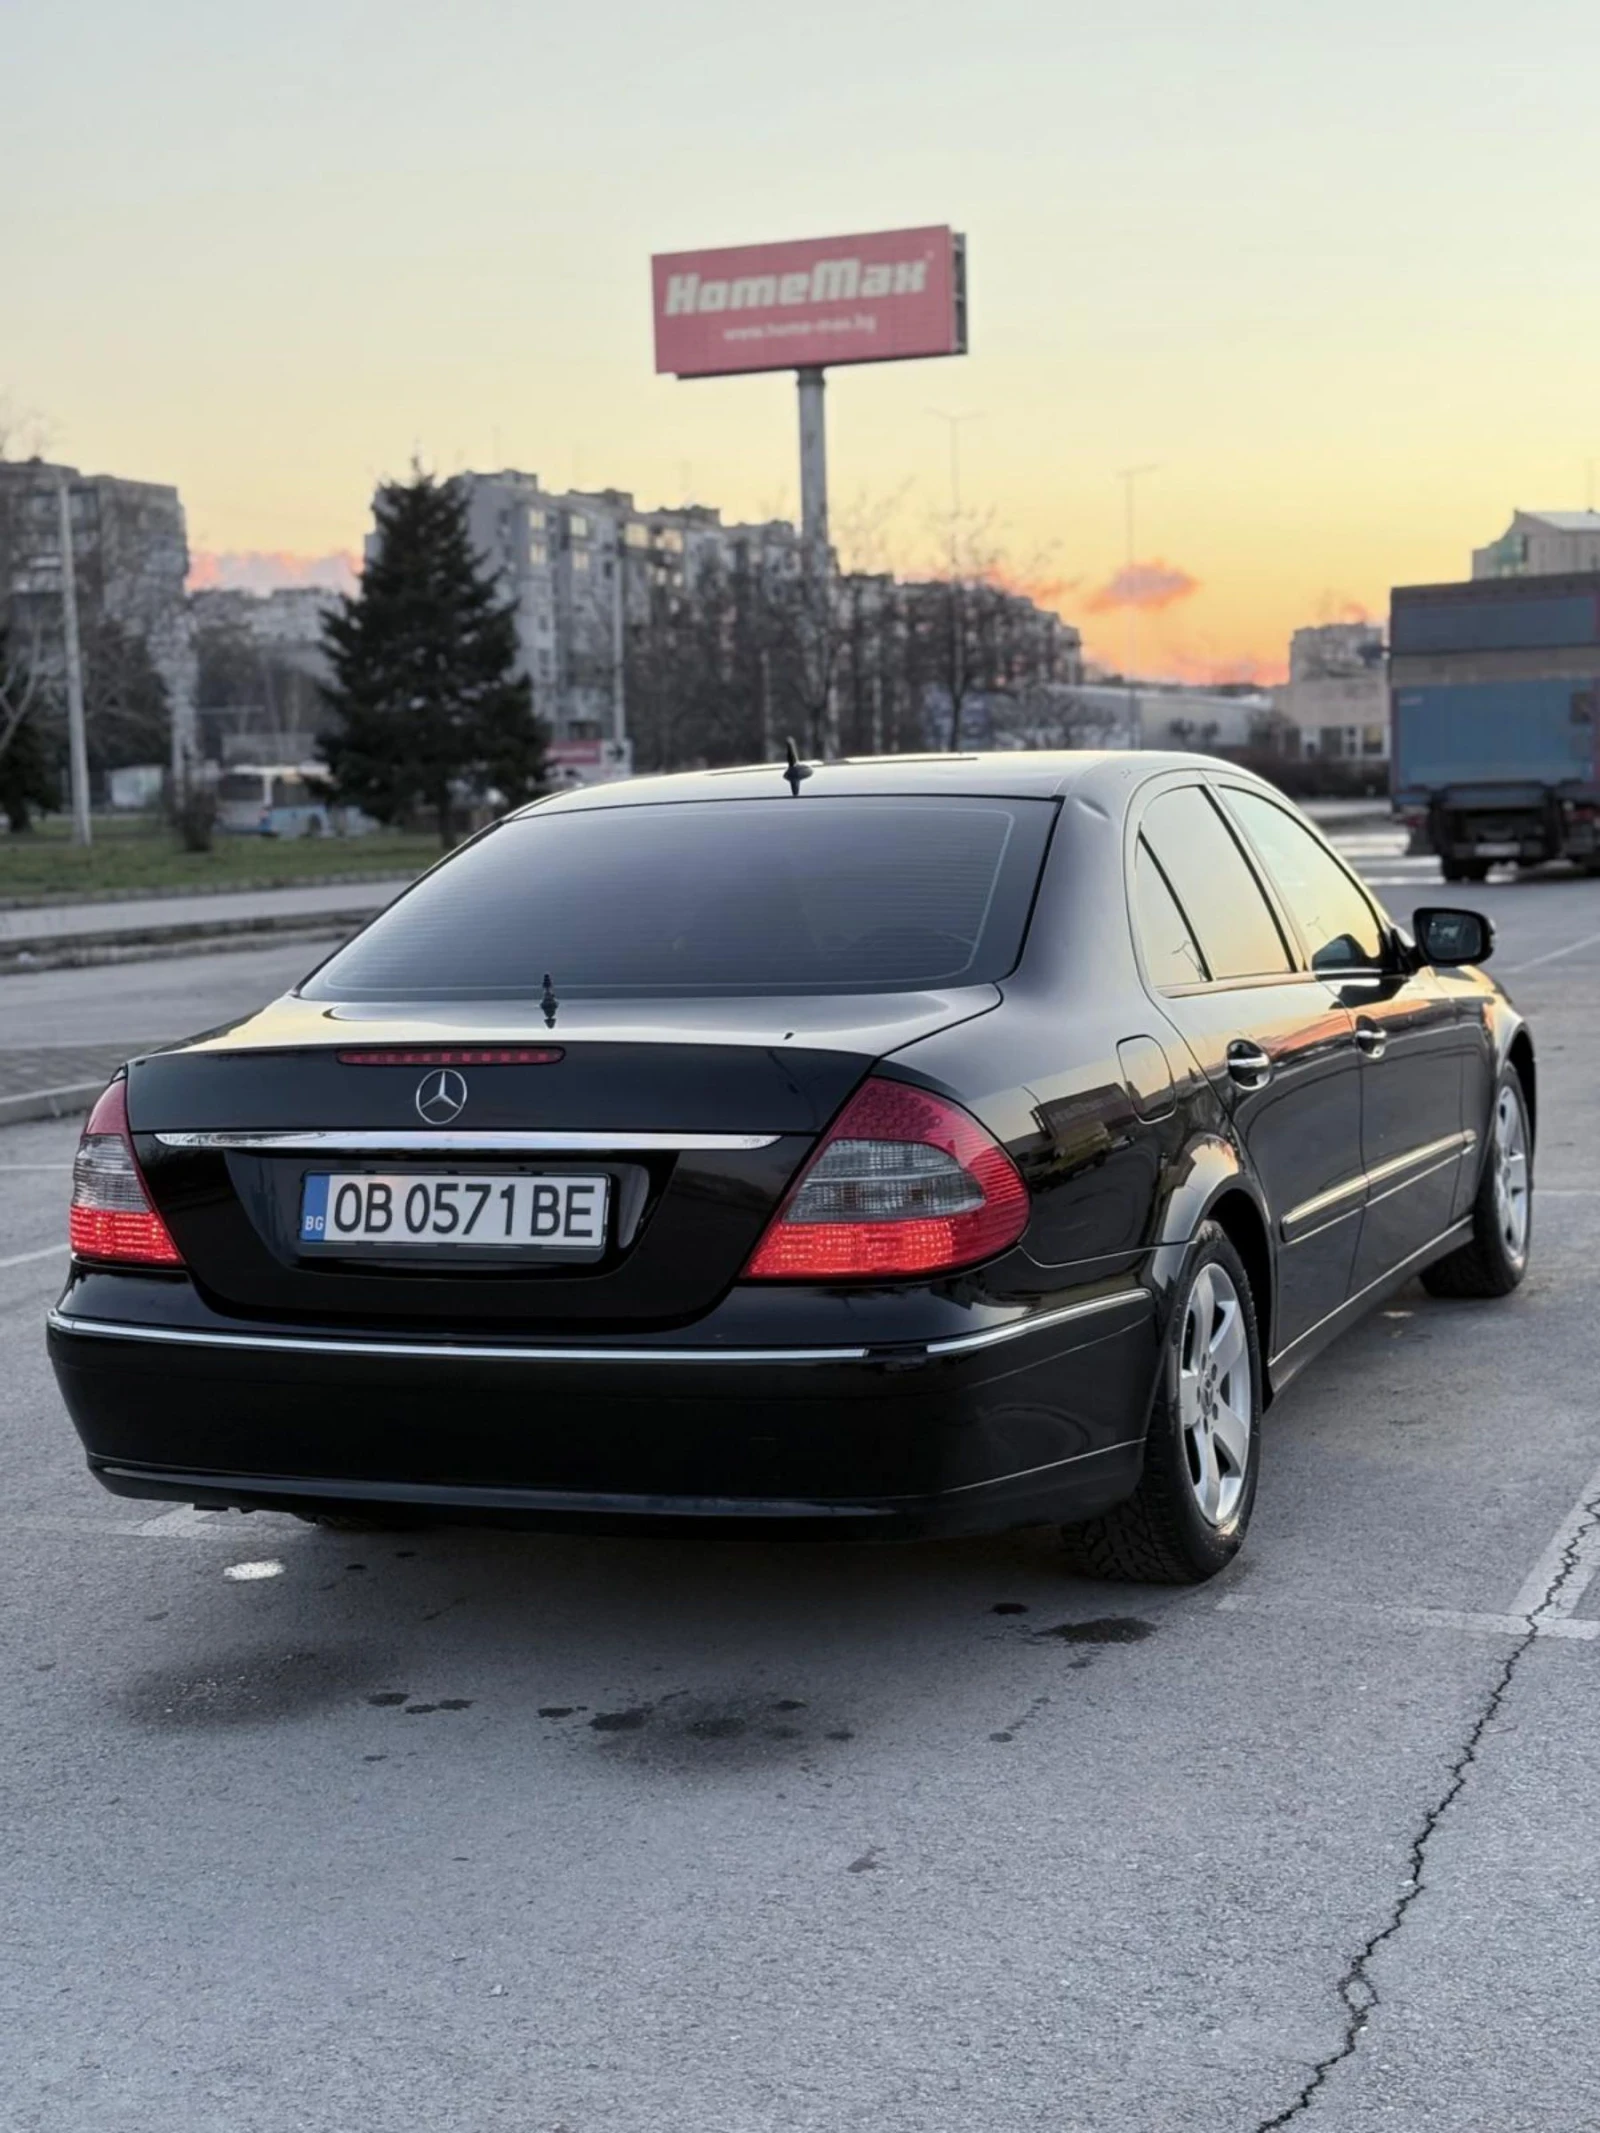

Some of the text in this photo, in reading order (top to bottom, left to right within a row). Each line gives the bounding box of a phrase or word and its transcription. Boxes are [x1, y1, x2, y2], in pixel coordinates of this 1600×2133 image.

[664, 257, 928, 316] HomeMax
[305, 1215, 324, 1231] BG
[334, 1182, 595, 1238] OB 0571 BE
